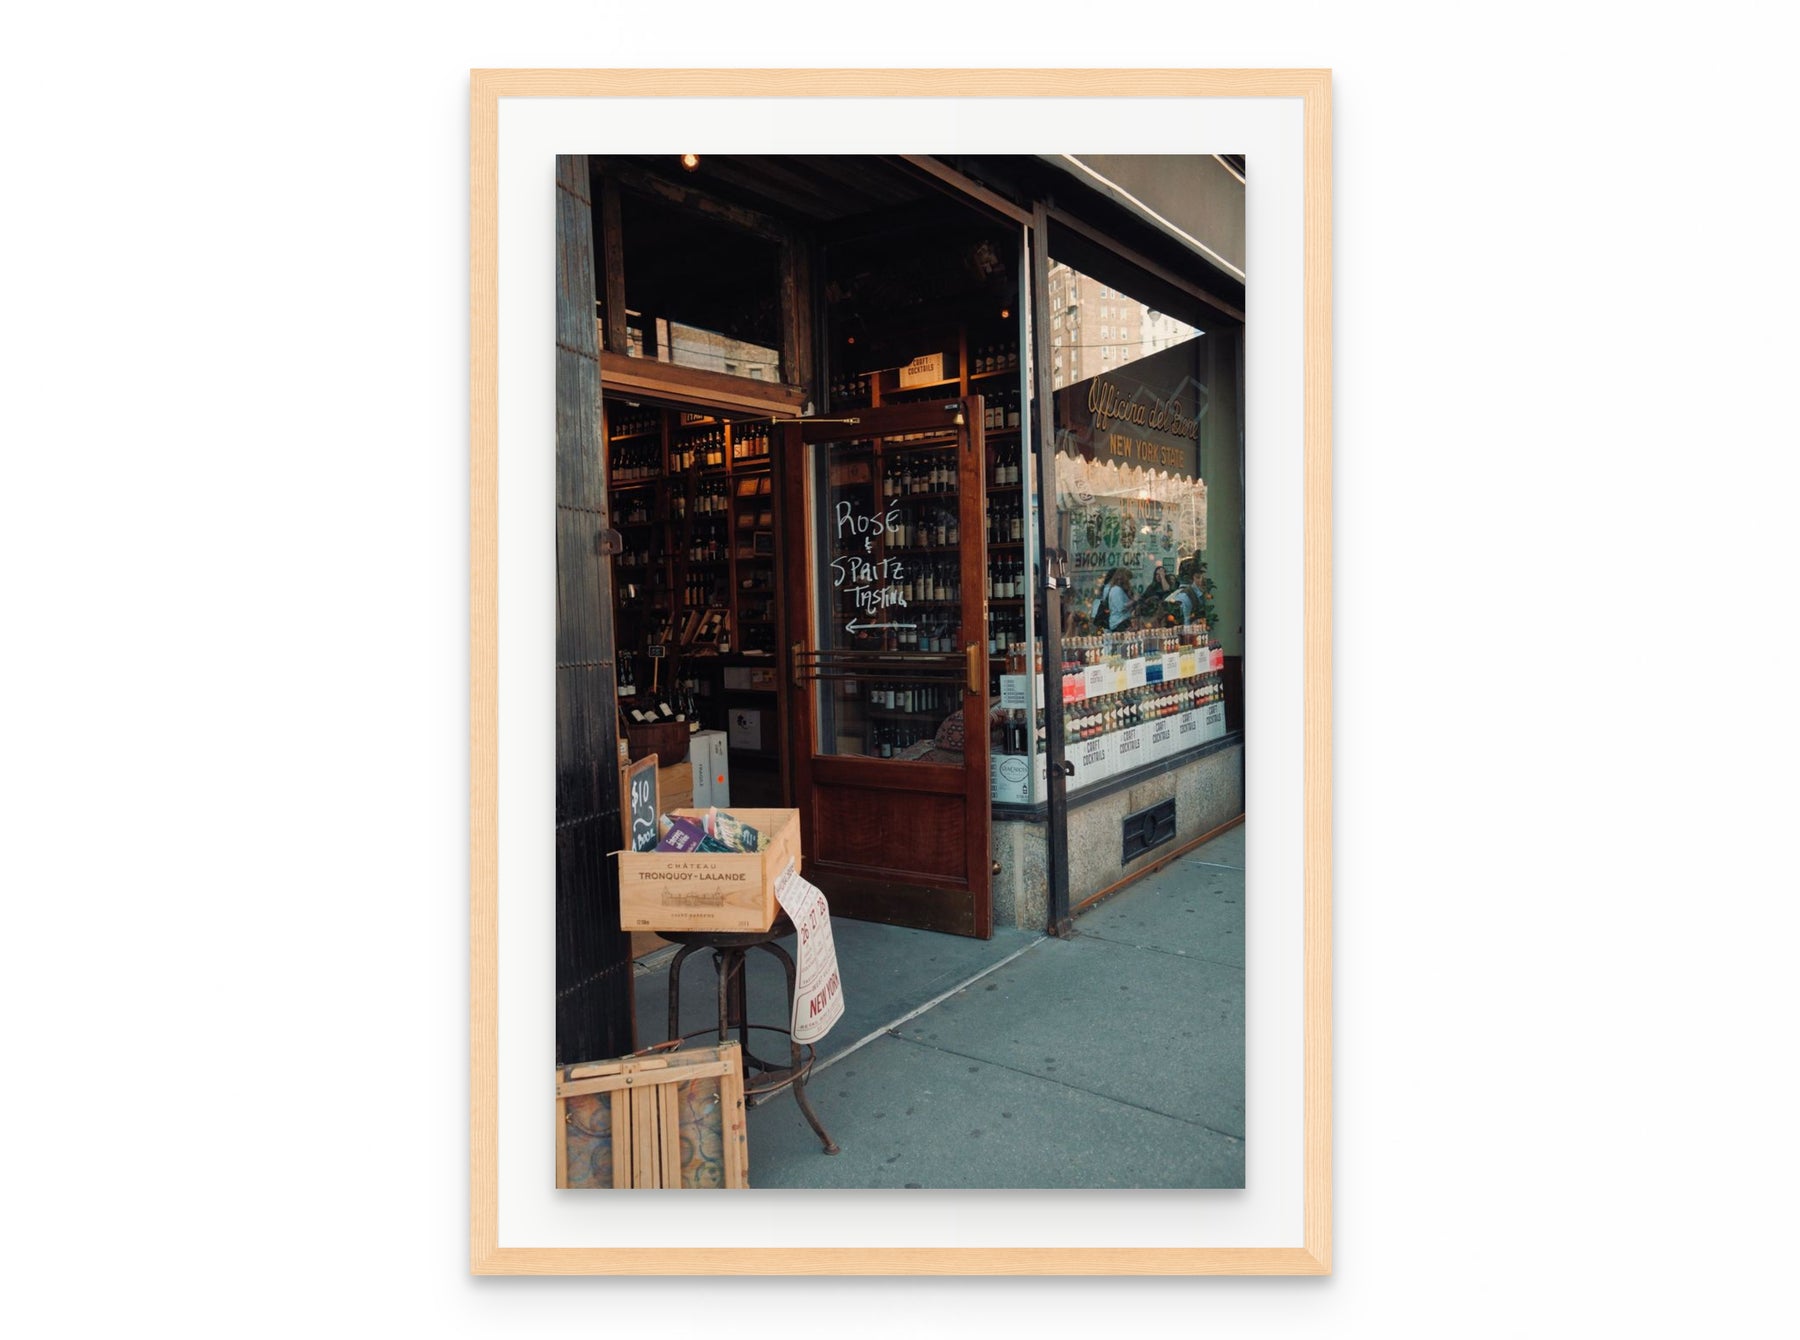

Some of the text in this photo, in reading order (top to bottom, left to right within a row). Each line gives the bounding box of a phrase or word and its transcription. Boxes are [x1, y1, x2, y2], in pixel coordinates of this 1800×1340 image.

[1089, 376, 1147, 431] Officina
[1148, 398, 1170, 432] del
[1110, 433, 1185, 470] NEW YORK STATE
[1182, 712, 1194, 723] CRAFT
[1206, 704, 1219, 716] CRAFT
[1155, 720, 1167, 732] CRAFT
[1206, 712, 1222, 726] COCKTAILS
[1180, 720, 1196, 735] COCKTAILS
[1123, 729, 1136, 742] CRAFT
[1152, 729, 1170, 744] COCKTAILS
[1086, 739, 1100, 753] CRAFT
[1119, 739, 1140, 754] COCKTAILS
[1083, 750, 1106, 766] COCKTAILS
[632, 780, 650, 815] $10
[638, 872, 747, 881] TRONQUOY-LALANDE
[801, 923, 810, 945] 26
[809, 909, 818, 930] 27
[810, 986, 828, 1018] NEW
